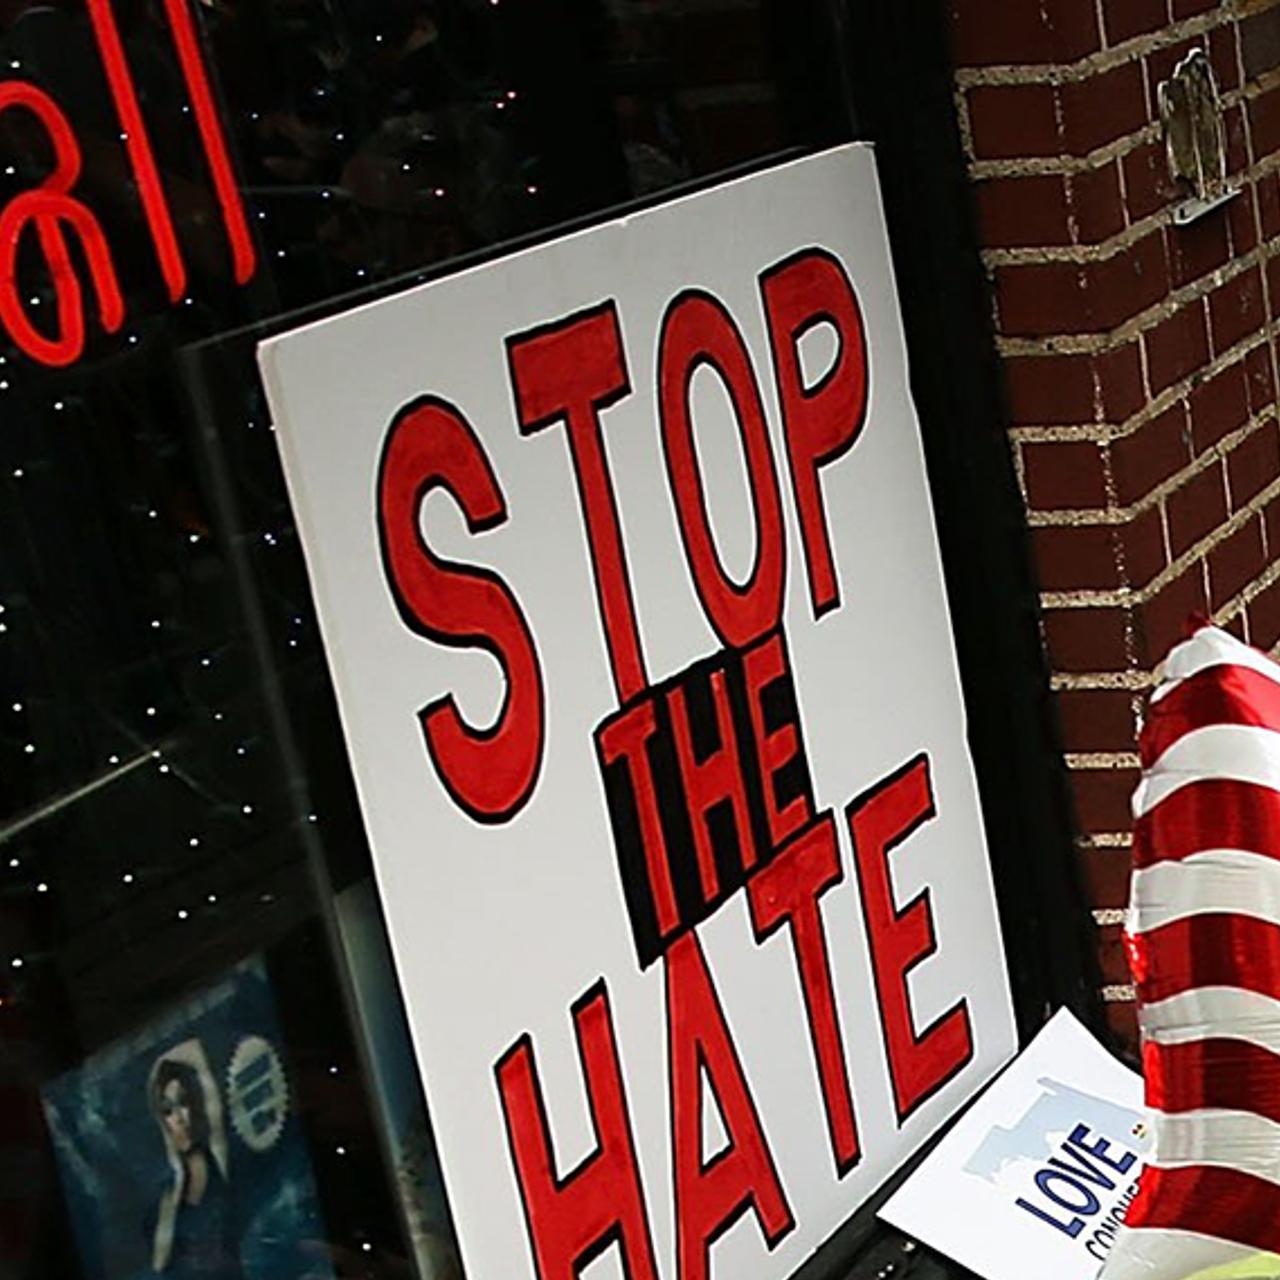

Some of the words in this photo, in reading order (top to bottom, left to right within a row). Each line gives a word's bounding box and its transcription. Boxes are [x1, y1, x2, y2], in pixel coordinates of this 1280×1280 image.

[377, 246, 870, 826] STOP
[595, 628, 814, 955] THE
[1014, 1122, 1138, 1240] LOVE
[1084, 1177, 1142, 1262] CONQUE
